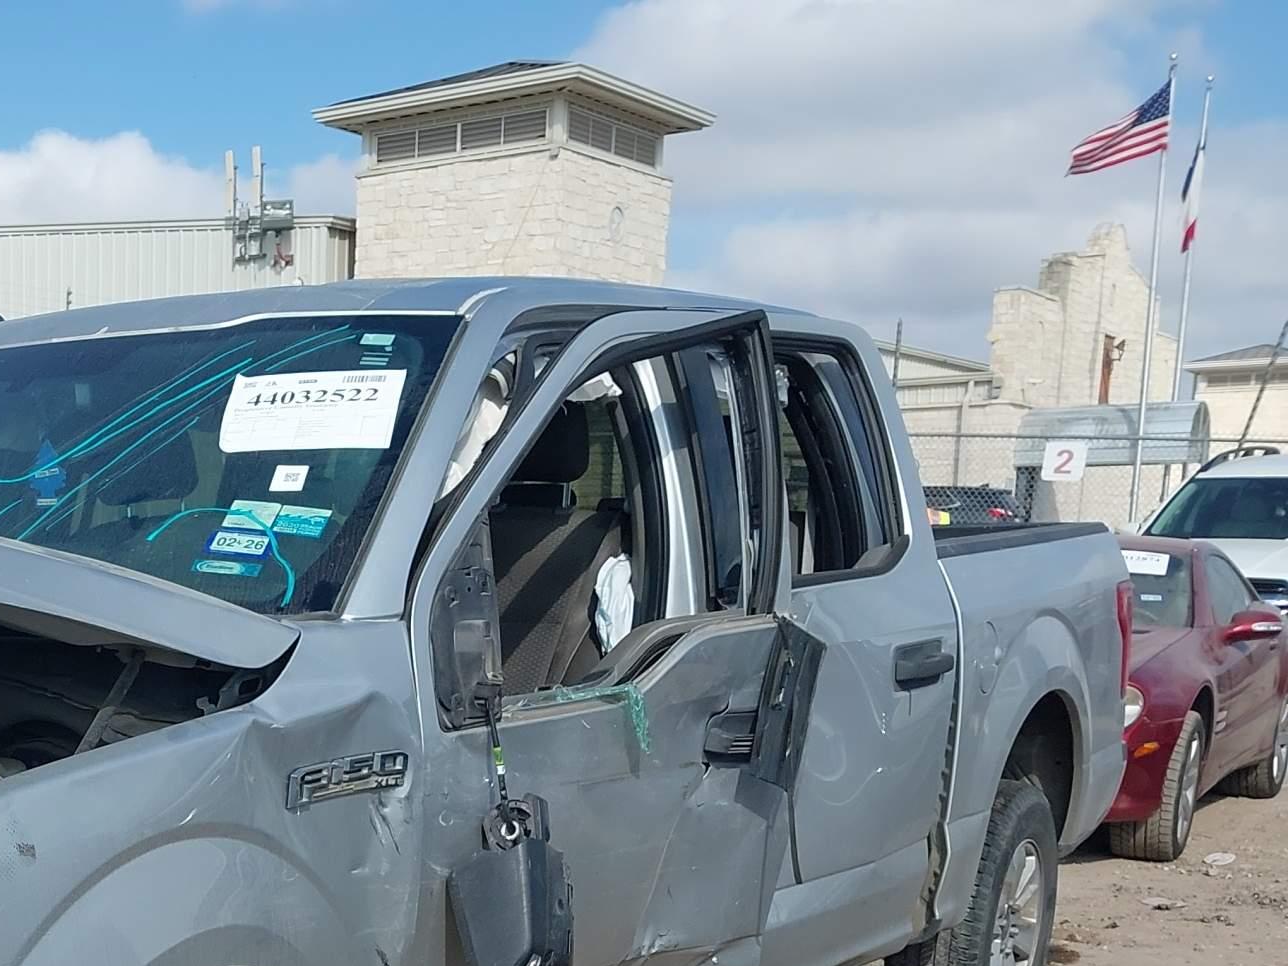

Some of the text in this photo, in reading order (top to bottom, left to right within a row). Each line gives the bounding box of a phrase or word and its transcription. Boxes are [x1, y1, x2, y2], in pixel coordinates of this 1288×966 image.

[246, 387, 379, 407] 44032522
[1053, 448, 1074, 475] 2
[374, 774, 404, 789] XLT
